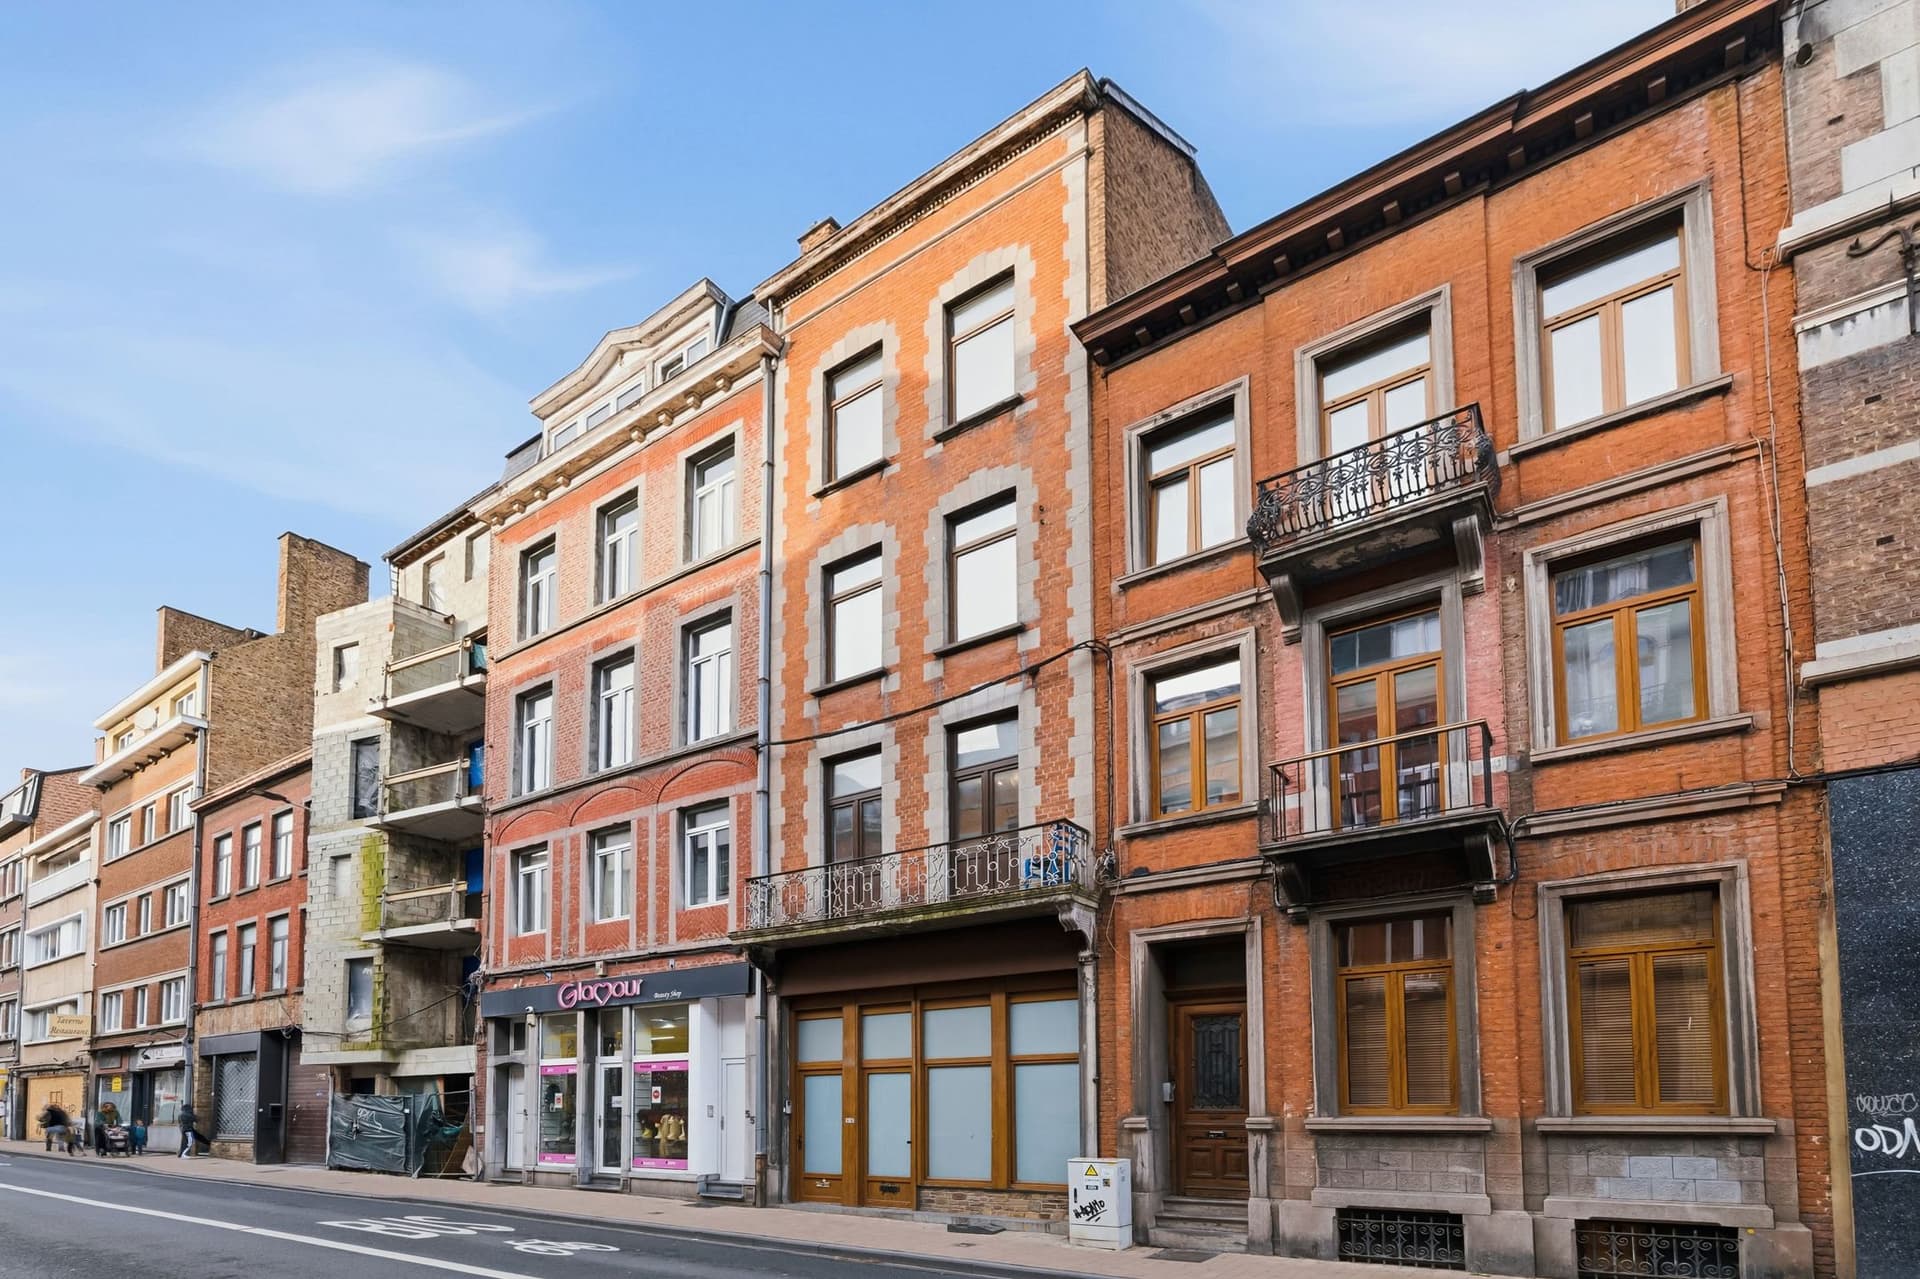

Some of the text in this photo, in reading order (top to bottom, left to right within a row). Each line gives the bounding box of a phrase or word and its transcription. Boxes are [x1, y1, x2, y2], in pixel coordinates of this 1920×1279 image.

[56, 1015, 84, 1025] Taverne
[50, 1025, 90, 1035] Restaurant
[316, 1215, 515, 1239] BUS
